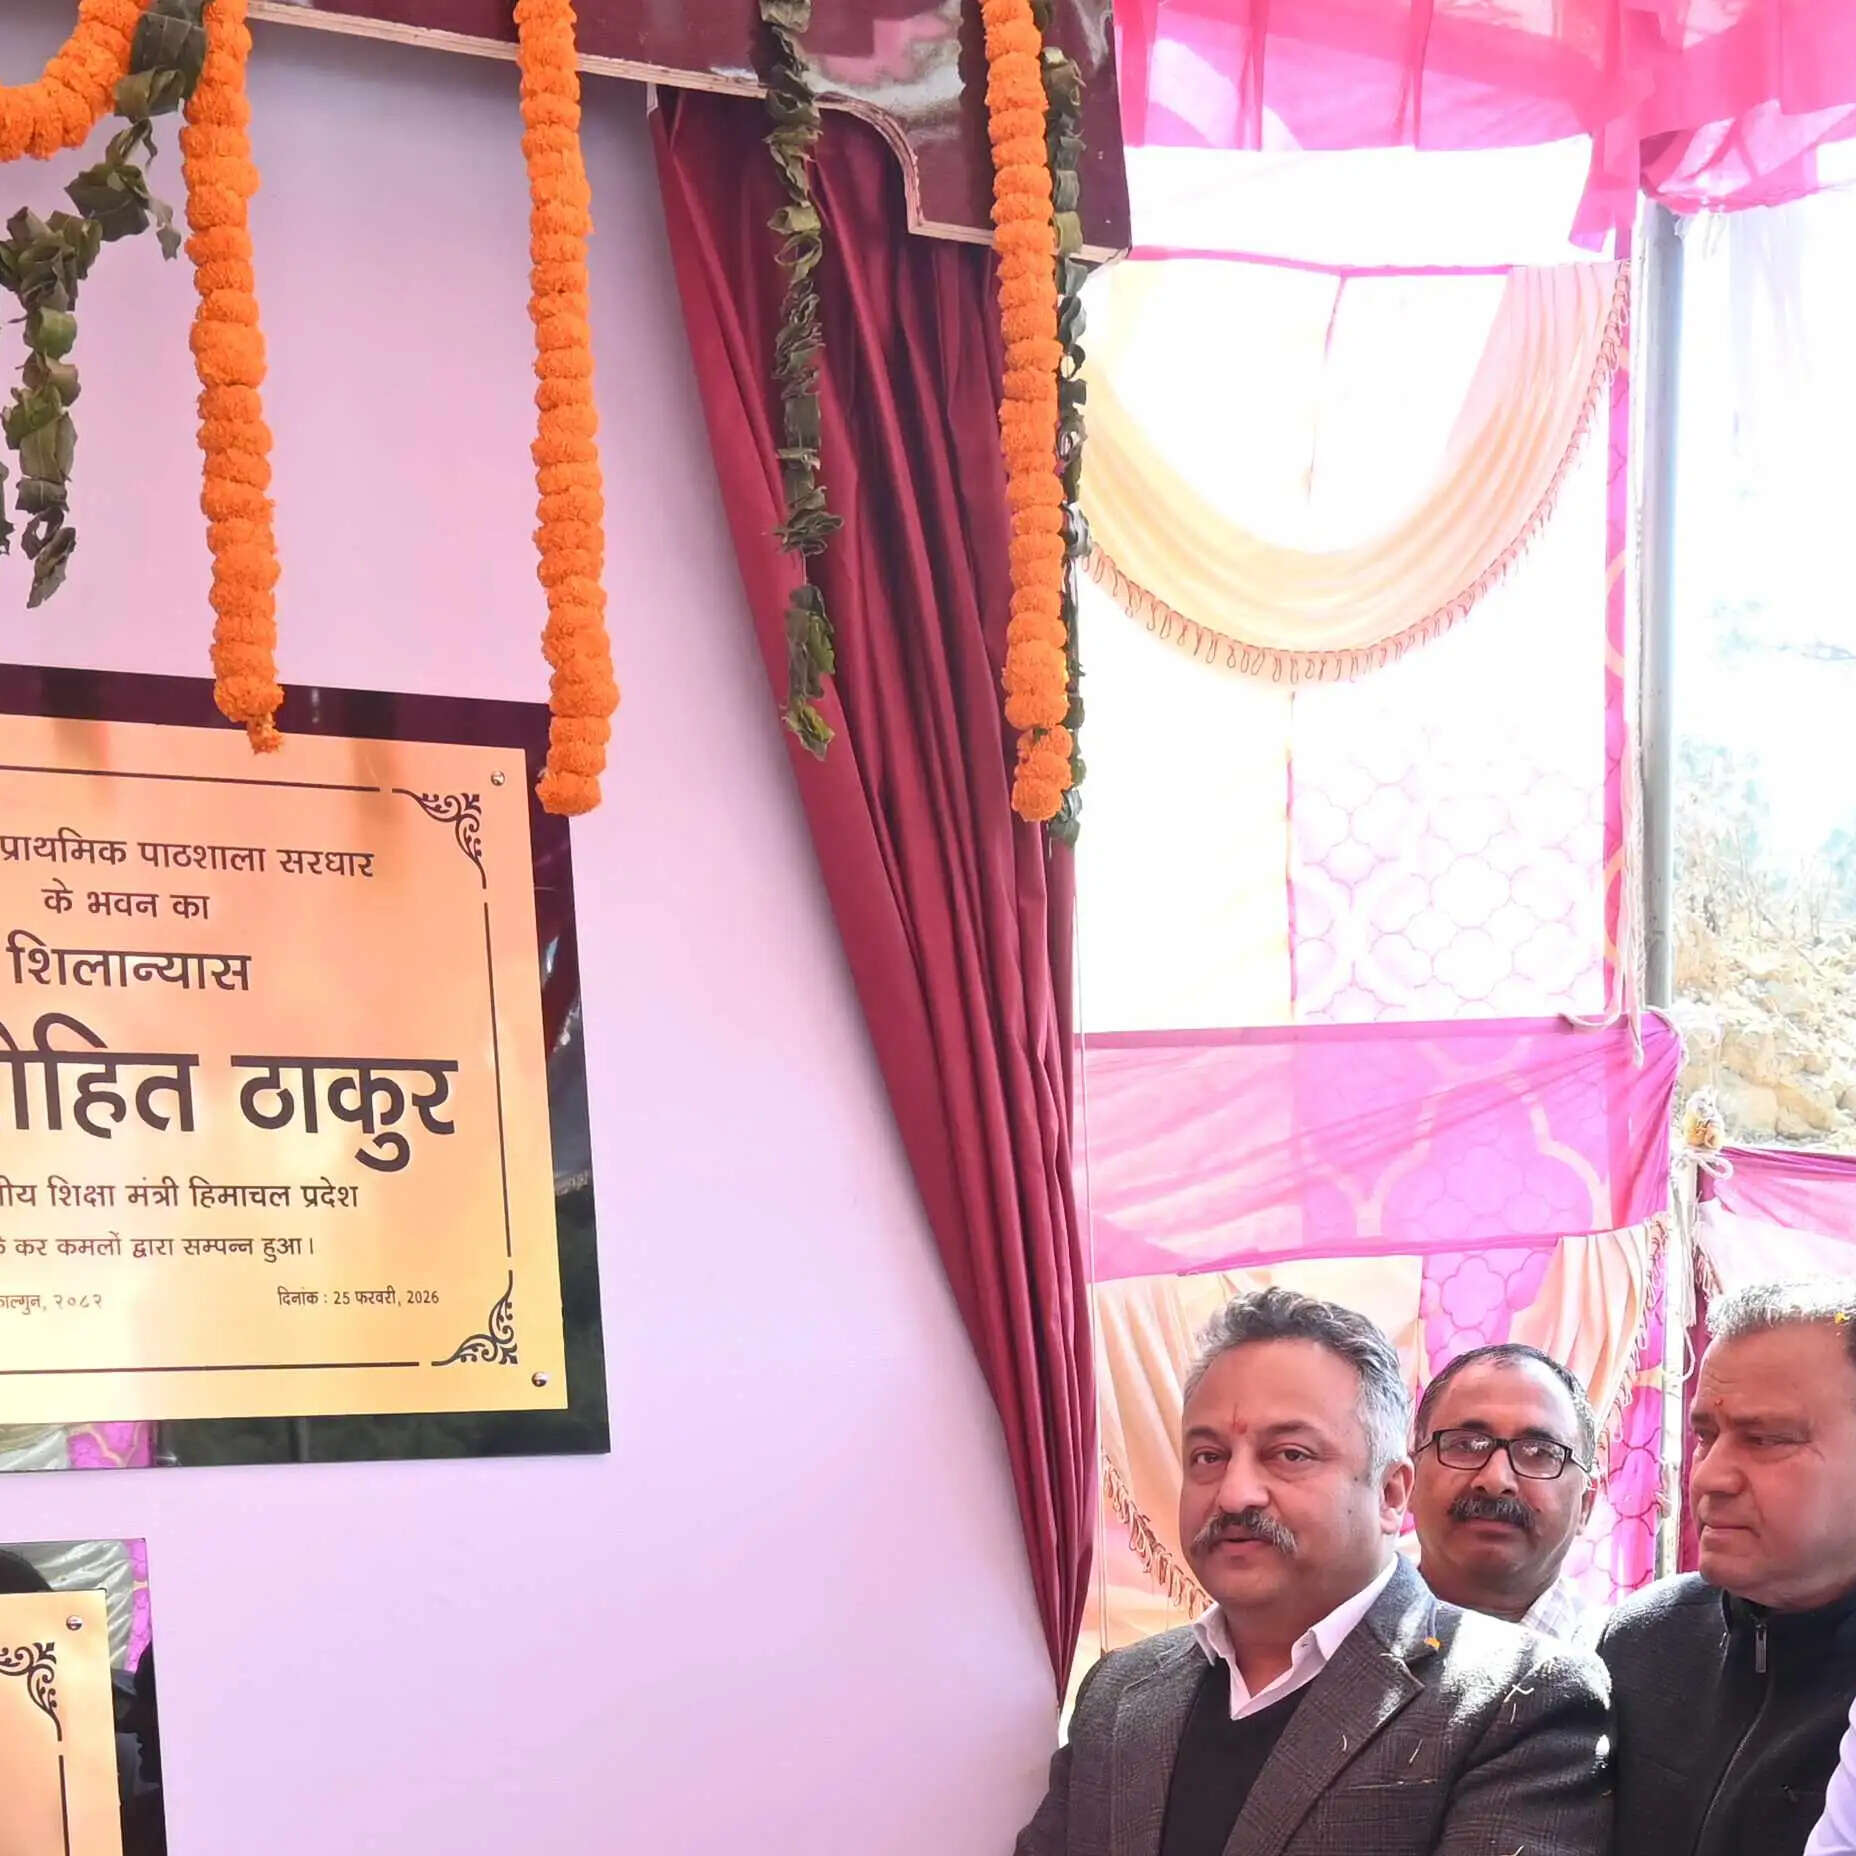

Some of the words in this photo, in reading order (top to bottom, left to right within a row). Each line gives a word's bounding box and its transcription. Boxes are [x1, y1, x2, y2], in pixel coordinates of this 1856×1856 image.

[136, 841, 267, 873] पाठशाला
[275, 848, 375, 878] सरधार
[40, 877, 74, 915] के
[86, 891, 160, 918] भवन
[169, 894, 211, 920] का
[5, 928, 253, 991] शिलान्यास
[230, 1054, 459, 1173] ठाकुर
[46, 1174, 116, 1208] शिक्षा
[124, 1175, 180, 1207] मंत्री
[188, 1175, 292, 1209] हिमाचल
[299, 1175, 359, 1209] प्रदेश
[13, 1238, 49, 1257] कर
[55, 1230, 123, 1257] कमलों
[129, 1238, 175, 1259] द्वारा
[180, 1237, 255, 1256] सम्पन्न
[52, 1293, 102, 1309] २०८२
[333, 1290, 351, 1305] 25
[354, 1284, 402, 1307] फरवरी,
[406, 1289, 440, 1305] 2026
